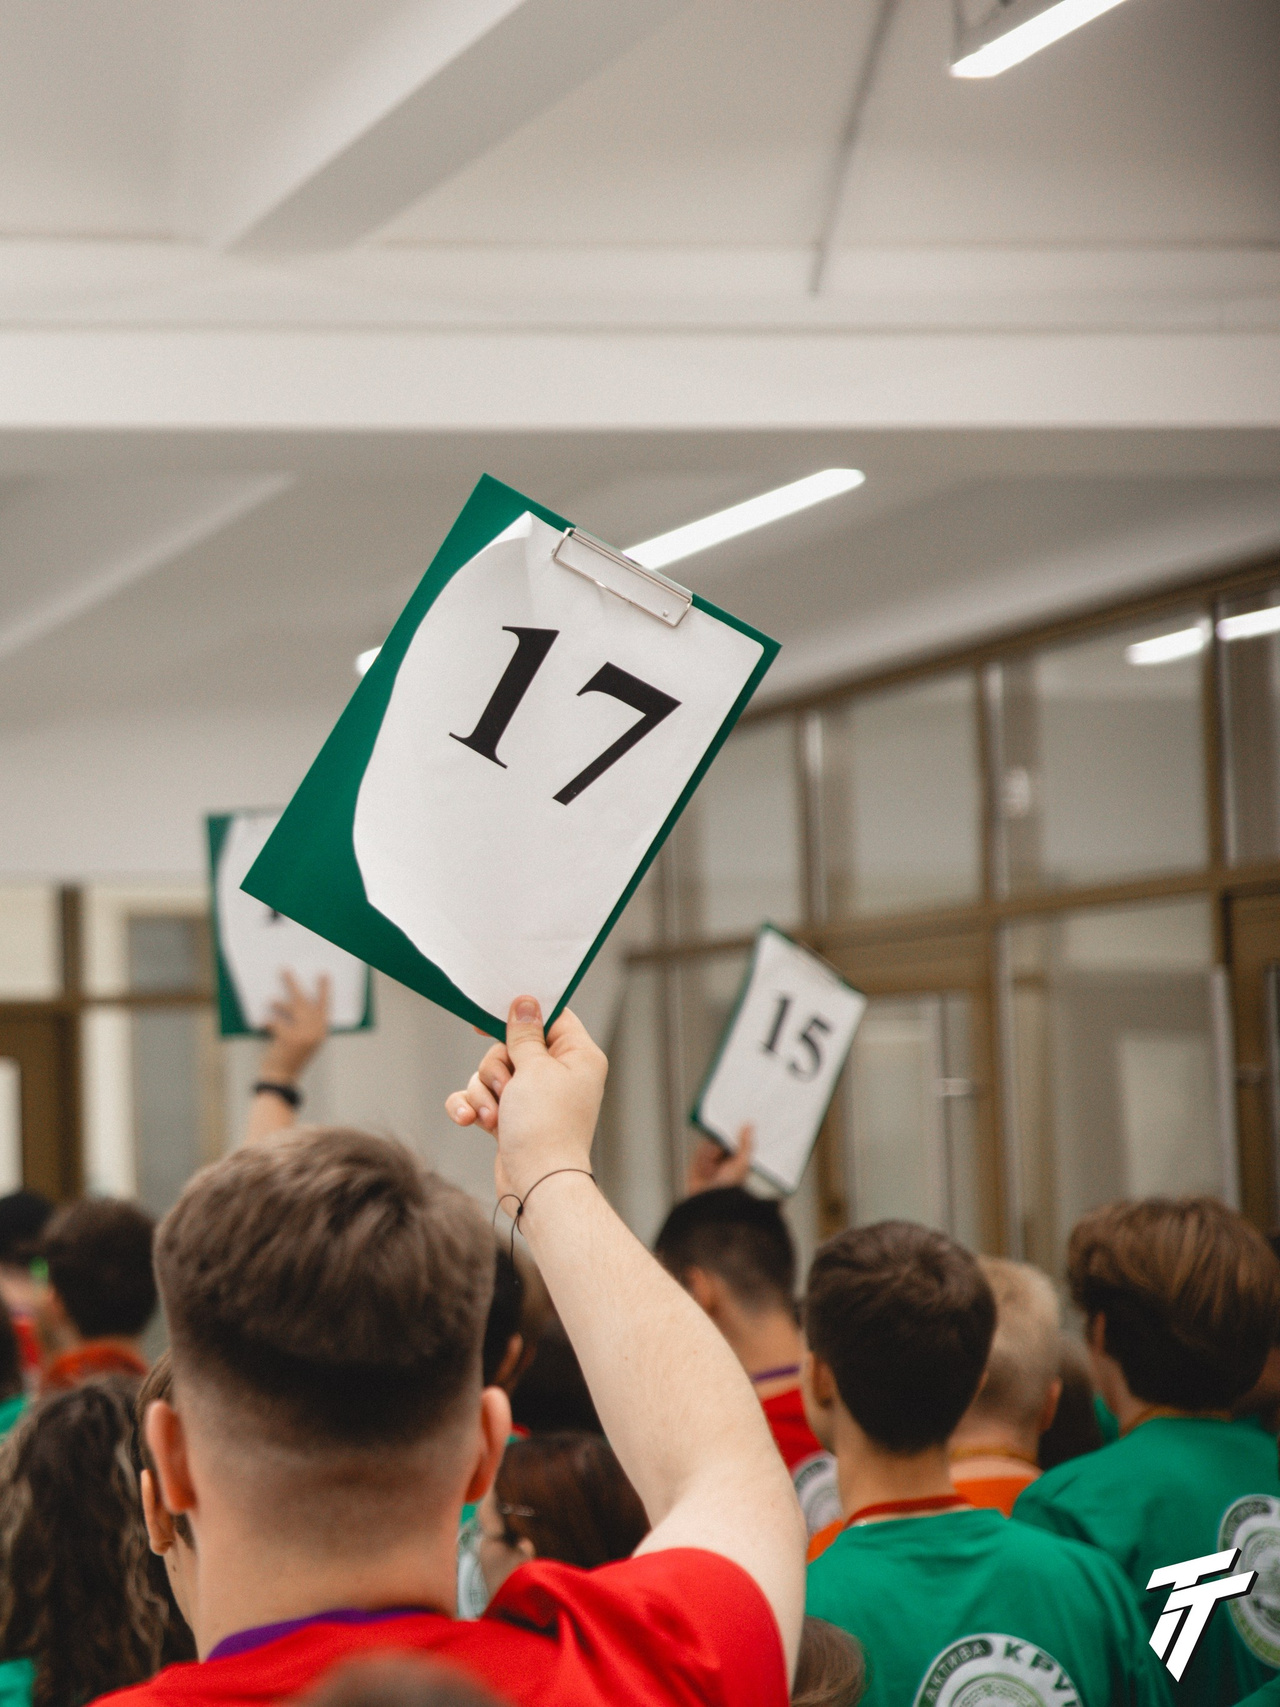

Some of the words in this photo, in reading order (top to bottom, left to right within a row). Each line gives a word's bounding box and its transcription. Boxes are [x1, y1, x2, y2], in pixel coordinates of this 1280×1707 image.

[448, 625, 683, 807] 17
[760, 993, 831, 1081] 15
[924, 1641, 987, 1701] АКТИВА
